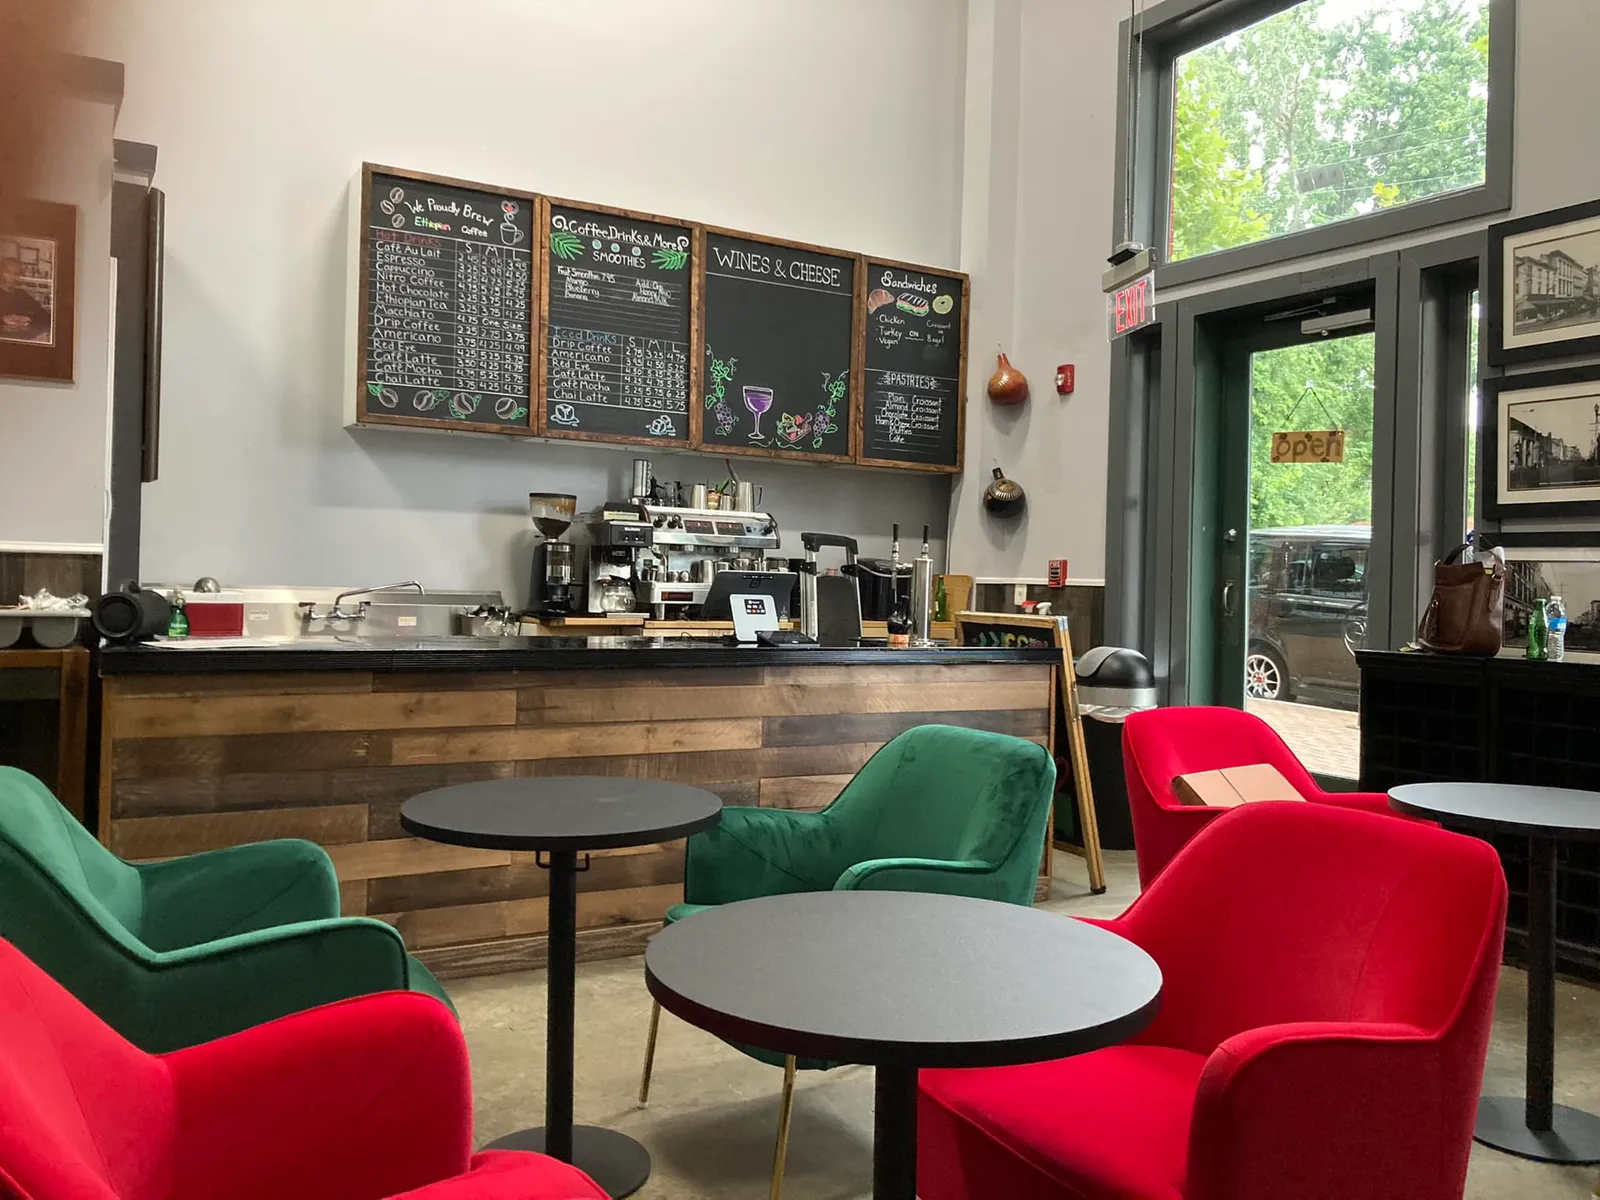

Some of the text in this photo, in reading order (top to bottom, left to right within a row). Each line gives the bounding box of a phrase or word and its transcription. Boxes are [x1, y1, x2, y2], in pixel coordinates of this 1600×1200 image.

[404, 198, 494, 226] We Proudly Brew
[376, 229, 521, 261] Hot Drinks S M L
[643, 236, 652, 247] &
[652, 233, 677, 250] More
[377, 252, 425, 266] Espresso
[405, 246, 418, 256] Au
[422, 247, 440, 258] Lait
[593, 251, 646, 269] SMOOTHIES
[713, 247, 840, 287] WINES & CHEESE
[376, 262, 434, 277] Cappuccino
[376, 272, 406, 282] Nitro
[410, 276, 444, 288] Coffee
[566, 276, 588, 286] Mango
[881, 271, 937, 294] Sandwiches
[376, 282, 396, 293] Hot
[400, 283, 449, 299] Chocolate
[566, 283, 599, 298] Blueberry
[376, 292, 426, 307] Ethiopian
[427, 299, 448, 310] Tea
[1116, 280, 1147, 333] EXIT
[374, 304, 434, 320] Macchiato
[482, 318, 500, 327] One
[502, 321, 522, 330] Size
[375, 314, 400, 328] Drip
[403, 319, 440, 331] Coffee
[879, 314, 905, 324] Chicken
[372, 327, 441, 343] Americano
[552, 326, 680, 353] Iced Drinks S M L
[879, 326, 902, 340] Turkey
[374, 339, 394, 350] Red
[398, 341, 416, 352] Eye
[552, 337, 575, 350] Drip
[578, 342, 612, 354] Coffee
[878, 336, 899, 349] Vegan
[405, 353, 438, 364] Latte
[551, 349, 610, 363] Americano
[552, 358, 570, 368] Red
[405, 364, 442, 375] Mocha
[579, 371, 606, 381] Latte
[375, 372, 401, 383] Chai
[405, 375, 440, 386] Latte
[580, 381, 611, 392] Mocha
[891, 373, 930, 390] PASTRIES
[553, 389, 577, 400] Chai
[579, 392, 608, 403] Latte
[886, 401, 908, 411] Almond
[875, 415, 889, 424] Ham
[889, 433, 905, 443] Cake
[1277, 438, 1340, 462] open
